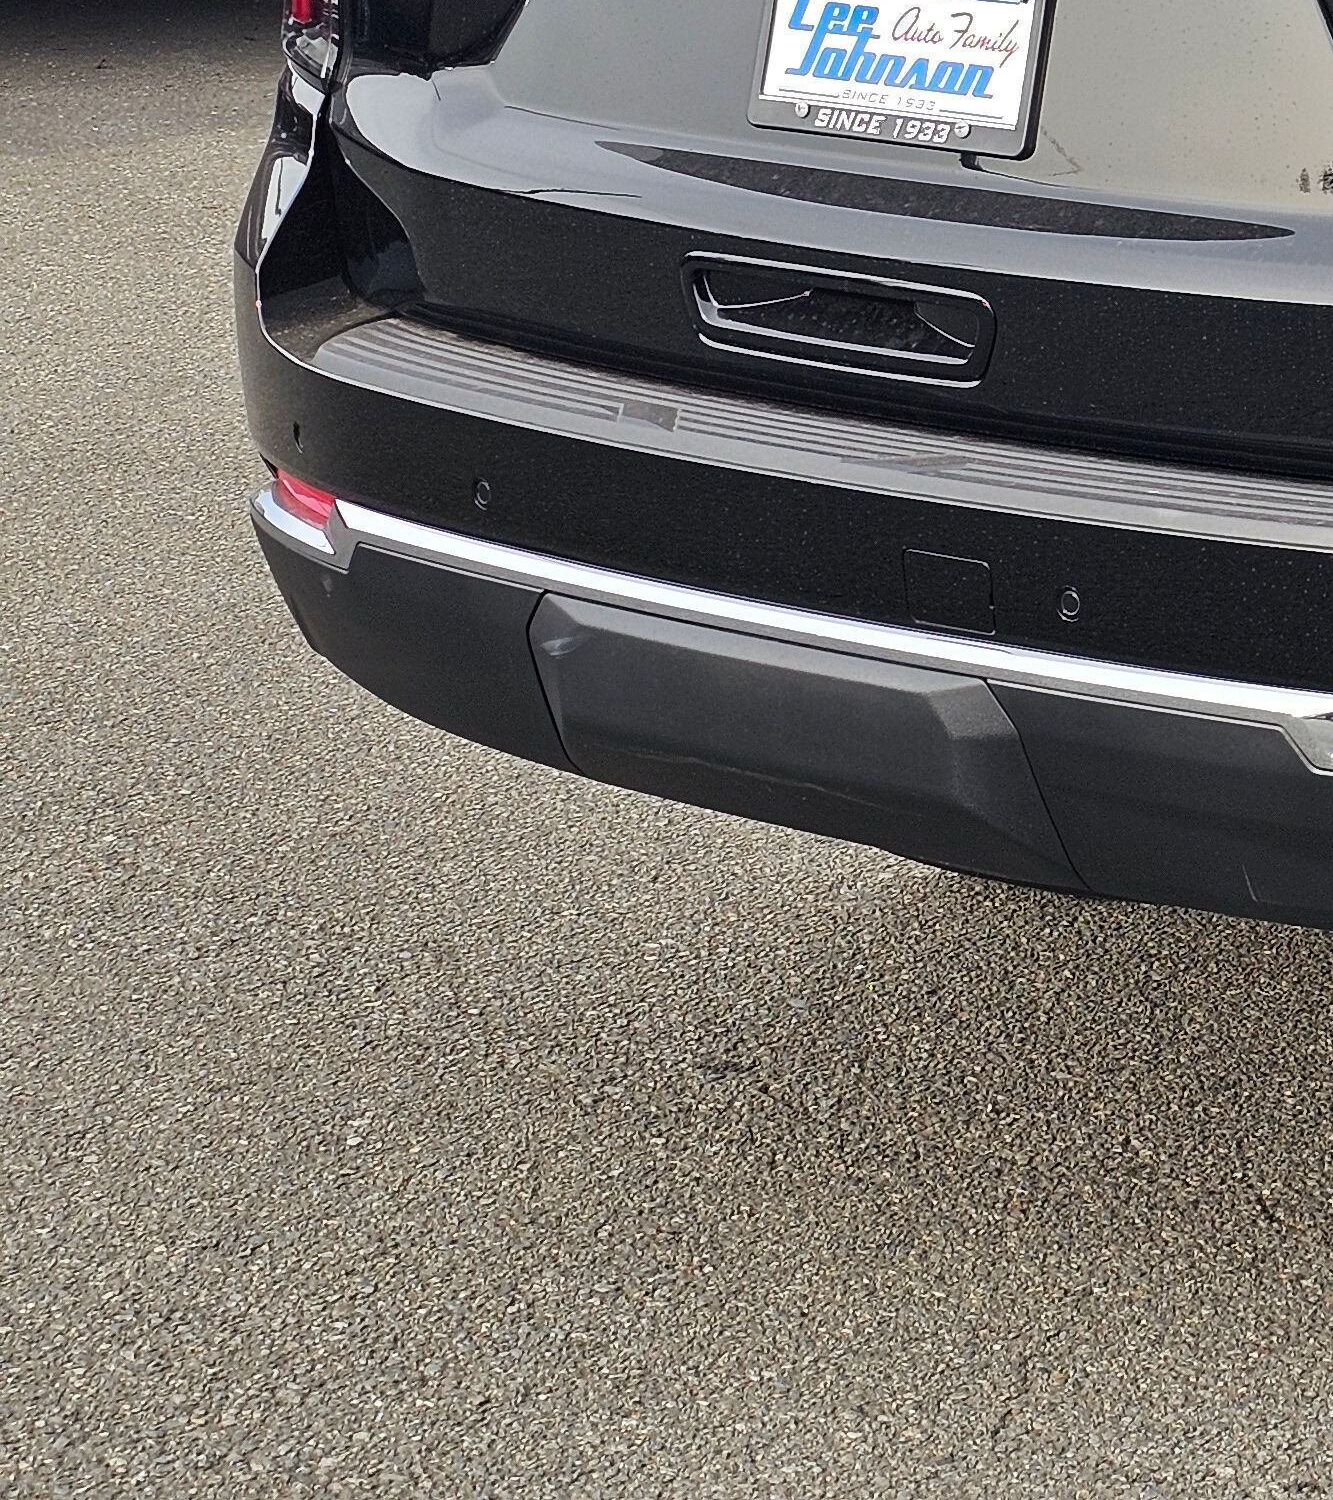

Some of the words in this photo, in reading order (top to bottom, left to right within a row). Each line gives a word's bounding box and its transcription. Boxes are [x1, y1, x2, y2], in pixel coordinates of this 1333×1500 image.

[785, 24, 994, 99] Johnson
[891, 6, 944, 46] Auto
[949, 11, 1020, 69] Family
[841, 89, 889, 105] SINCE
[897, 97, 935, 110] 1933
[814, 108, 887, 135] SINCE
[892, 117, 950, 144] 1933
